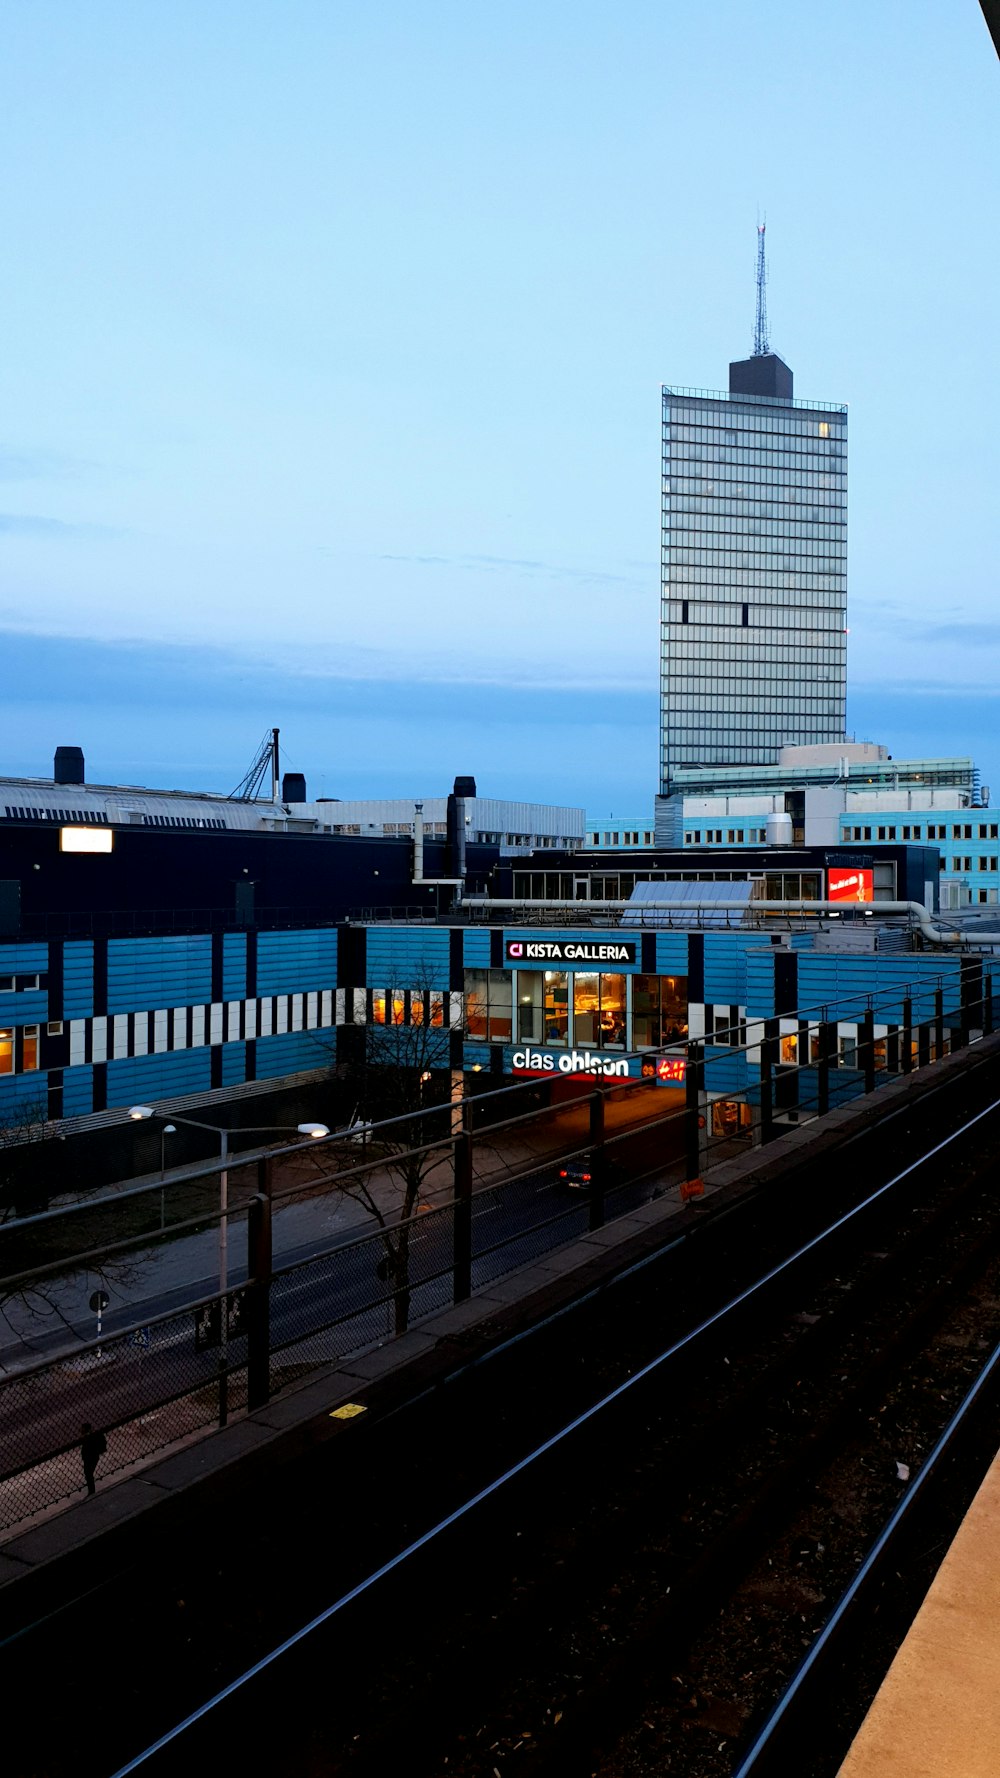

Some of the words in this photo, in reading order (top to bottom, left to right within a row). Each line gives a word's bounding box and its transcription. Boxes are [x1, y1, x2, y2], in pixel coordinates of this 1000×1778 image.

[526, 943, 562, 957] KISTA
[564, 945, 629, 959] GALLERIA
[512, 1048, 554, 1070] clas
